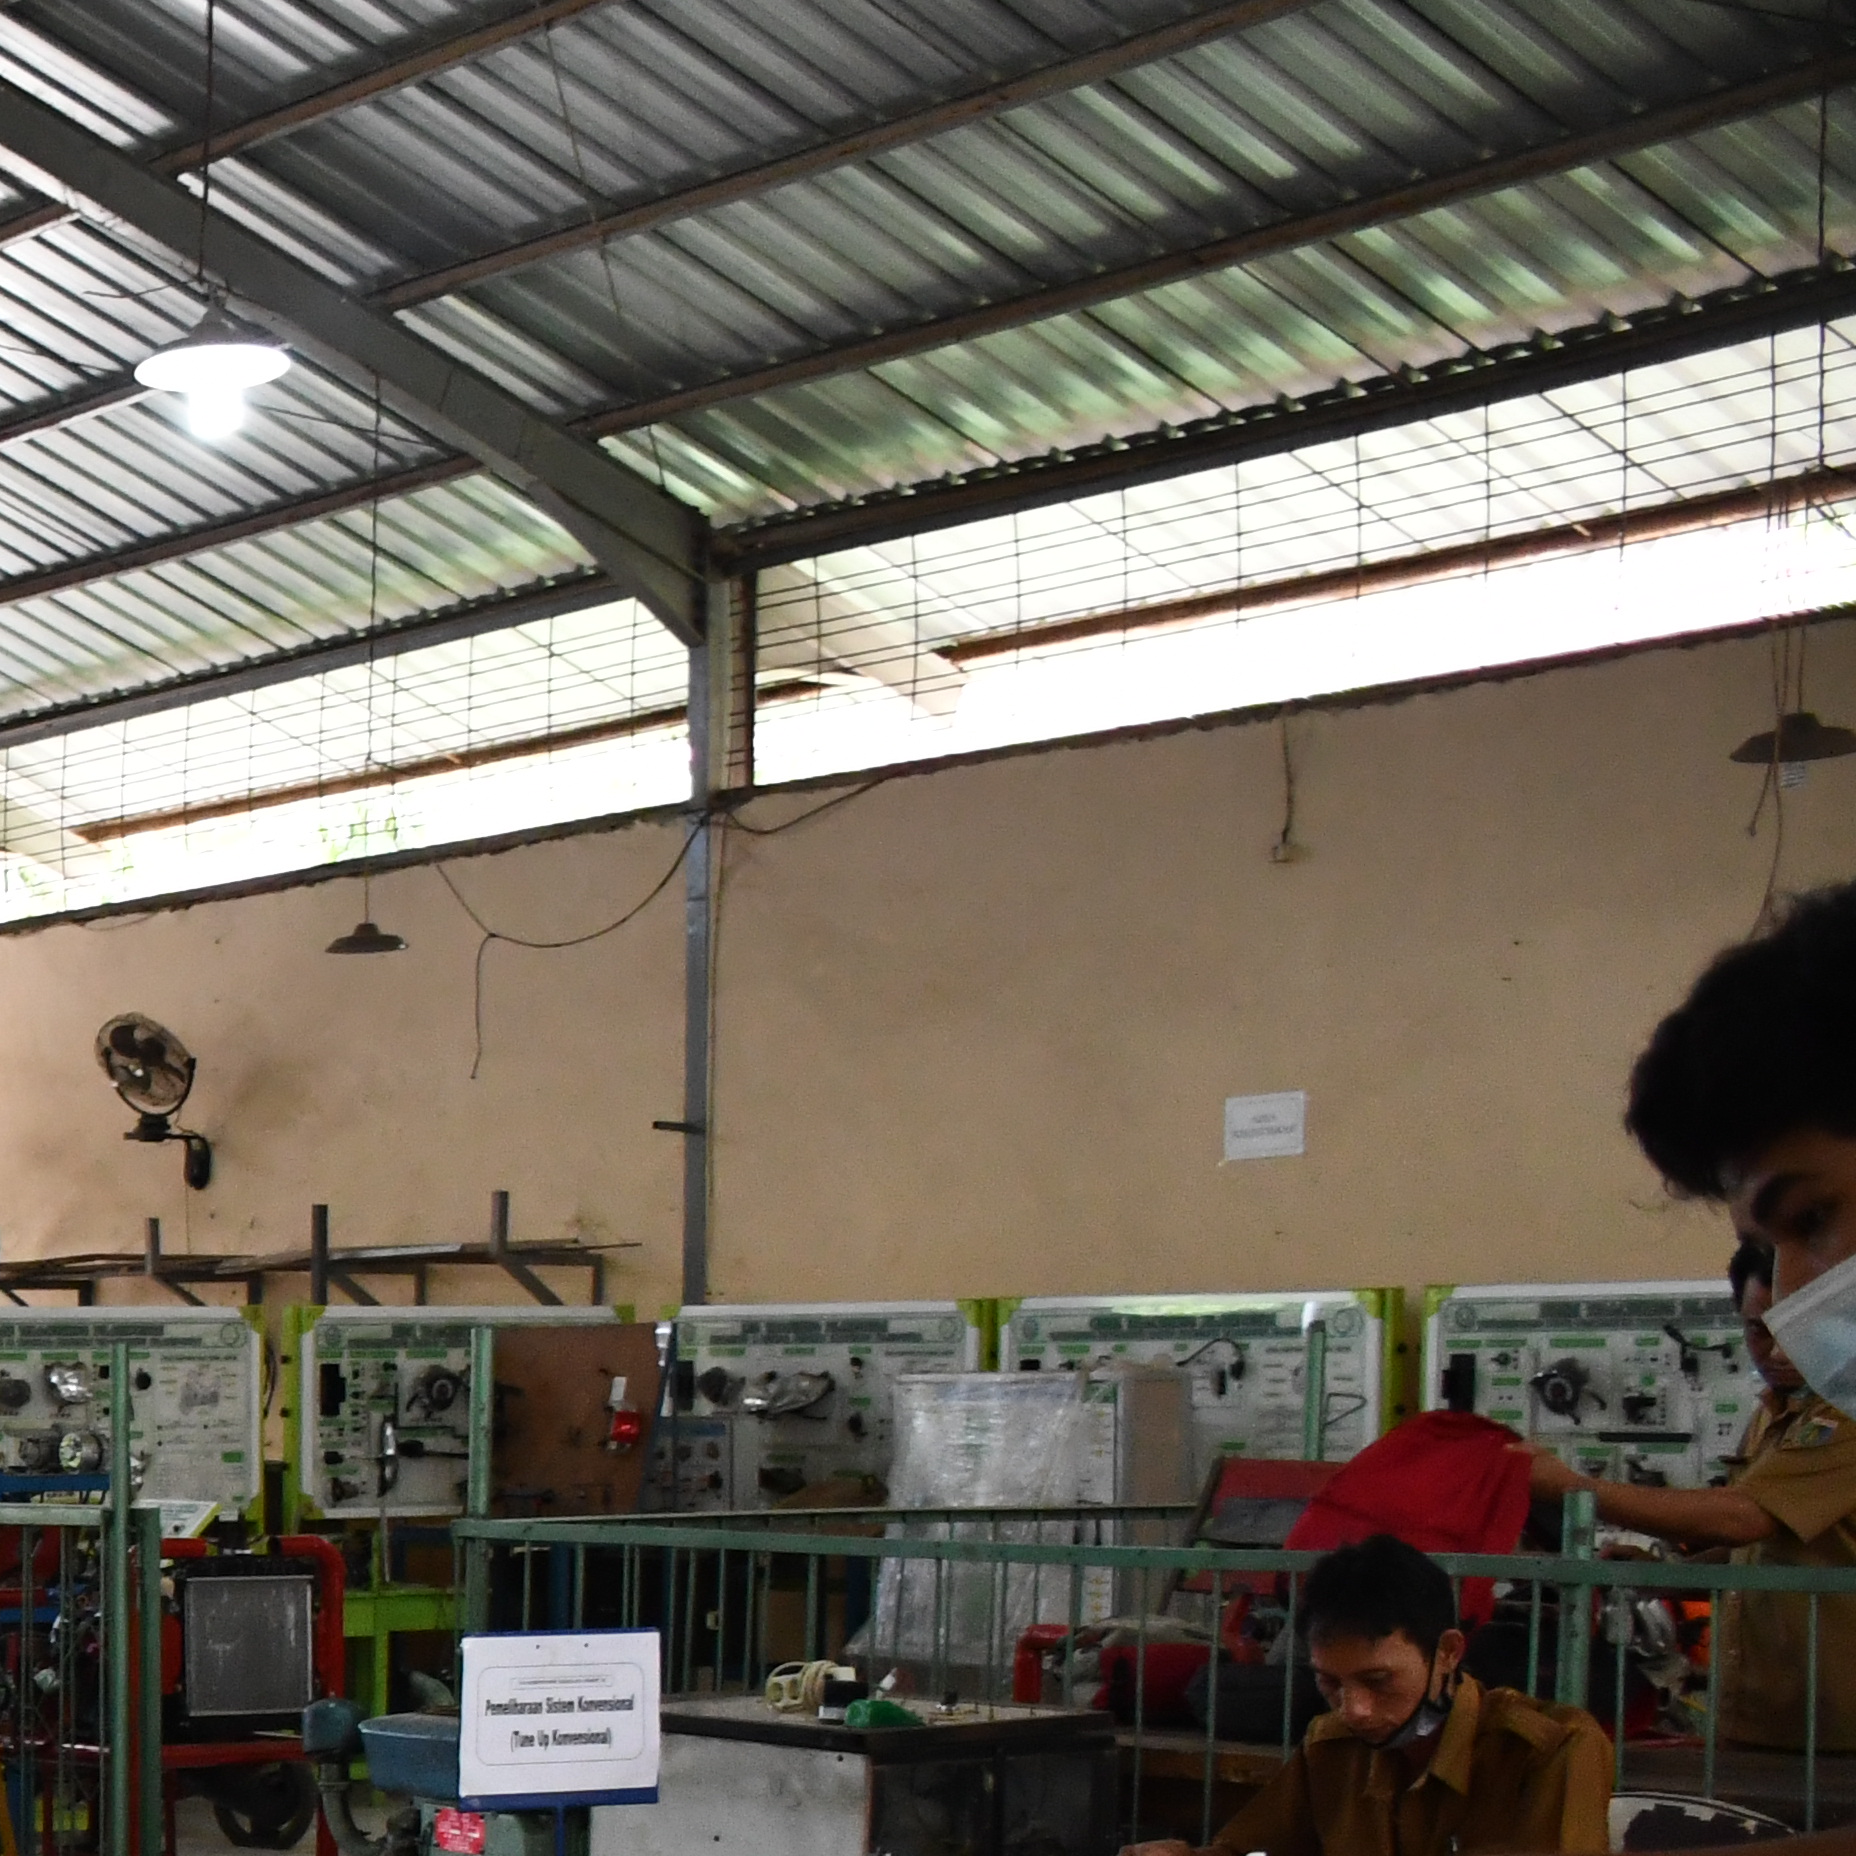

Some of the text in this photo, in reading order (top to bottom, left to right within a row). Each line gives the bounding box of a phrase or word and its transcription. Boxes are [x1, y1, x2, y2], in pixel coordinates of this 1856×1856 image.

[545, 1696, 575, 1714] Sistem
[577, 1694, 634, 1713] Konvensional
[510, 1730, 535, 1752] (Tune
[537, 1729, 550, 1751] Up
